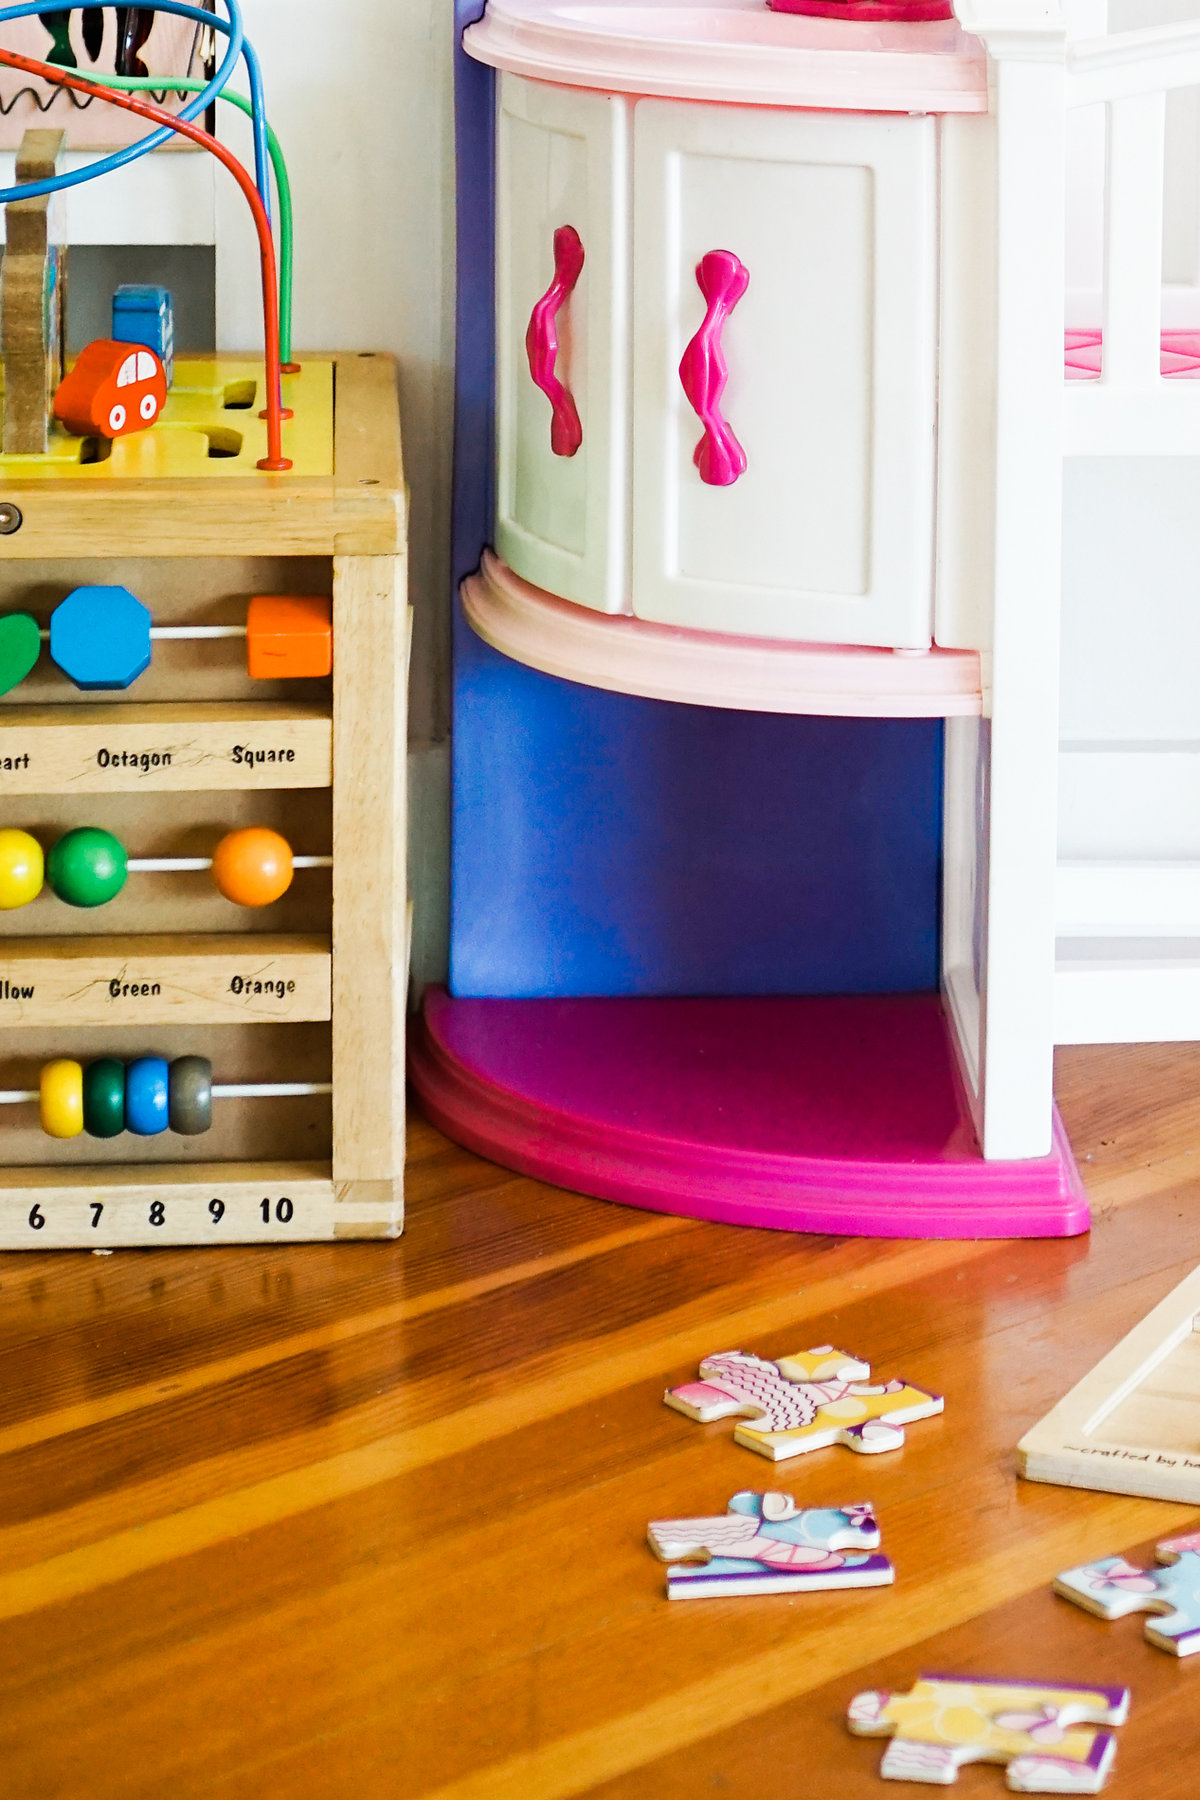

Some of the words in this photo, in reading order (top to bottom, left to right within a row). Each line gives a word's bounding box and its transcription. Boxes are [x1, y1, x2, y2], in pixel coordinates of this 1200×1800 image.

[0, 753, 31, 771] art
[97, 748, 172, 772] Octagon
[231, 745, 296, 769] Square
[0, 980, 35, 999] llow
[108, 979, 162, 998] Green
[230, 975, 296, 999] Orange
[28, 1203, 46, 1230] 6
[89, 1202, 104, 1228] 7
[148, 1200, 166, 1227] 8
[208, 1198, 226, 1225] 9
[260, 1197, 294, 1224] 10
[1155, 1455, 1177, 1467] by
